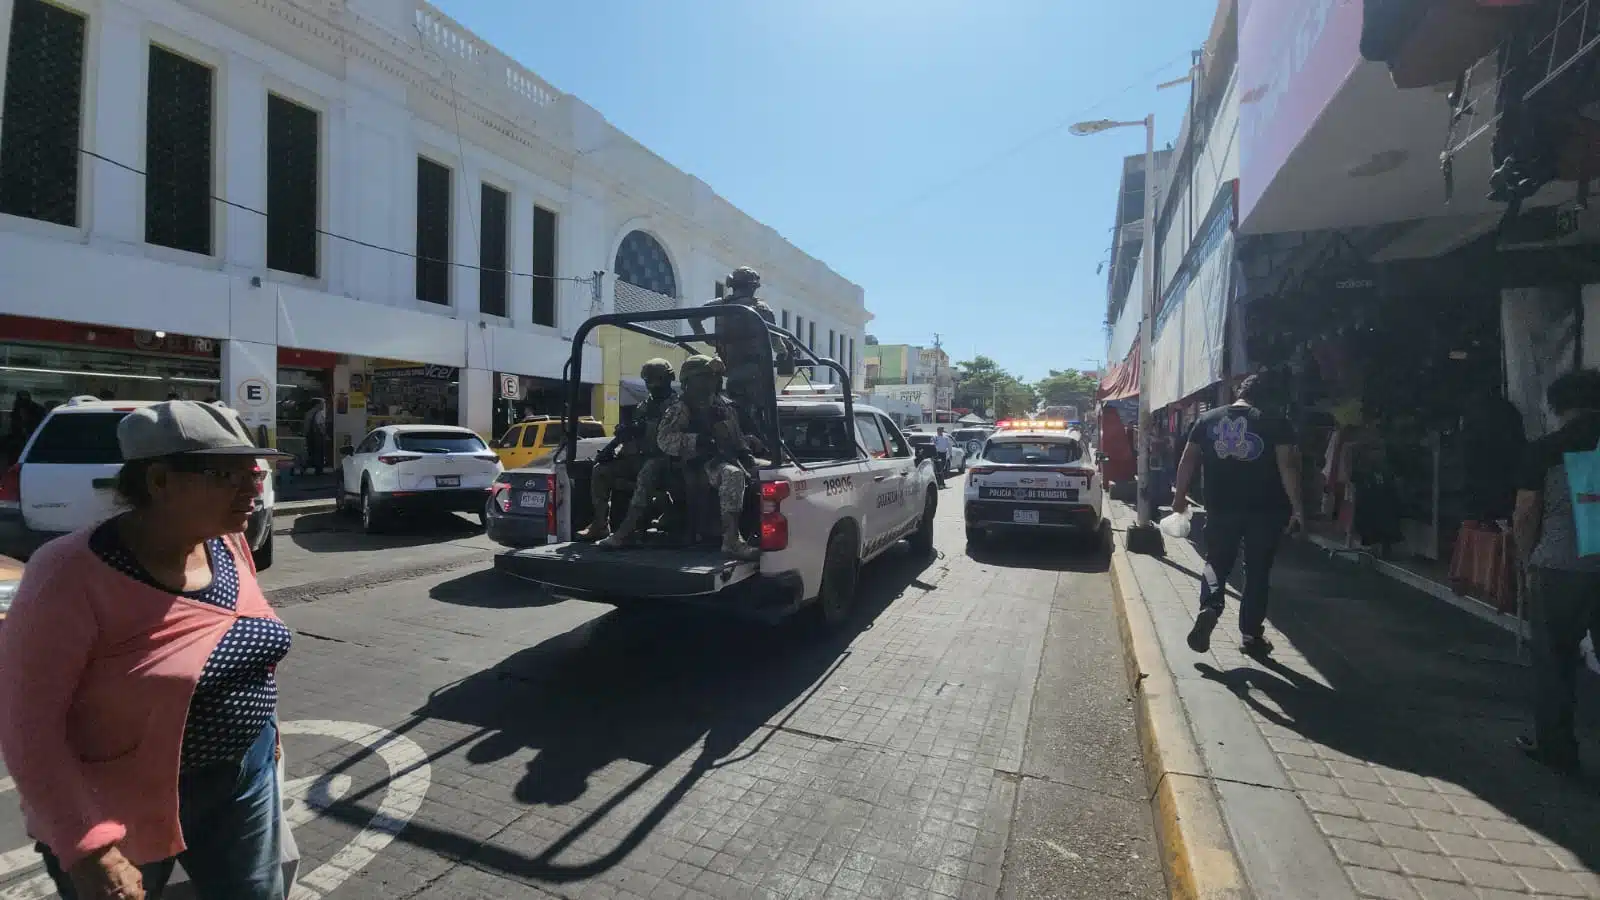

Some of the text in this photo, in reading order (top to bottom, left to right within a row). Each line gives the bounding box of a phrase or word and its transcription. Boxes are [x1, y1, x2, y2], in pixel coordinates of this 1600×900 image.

[247, 385, 261, 400] E
[508, 380, 513, 393] E
[1028, 490, 1036, 498] DE
